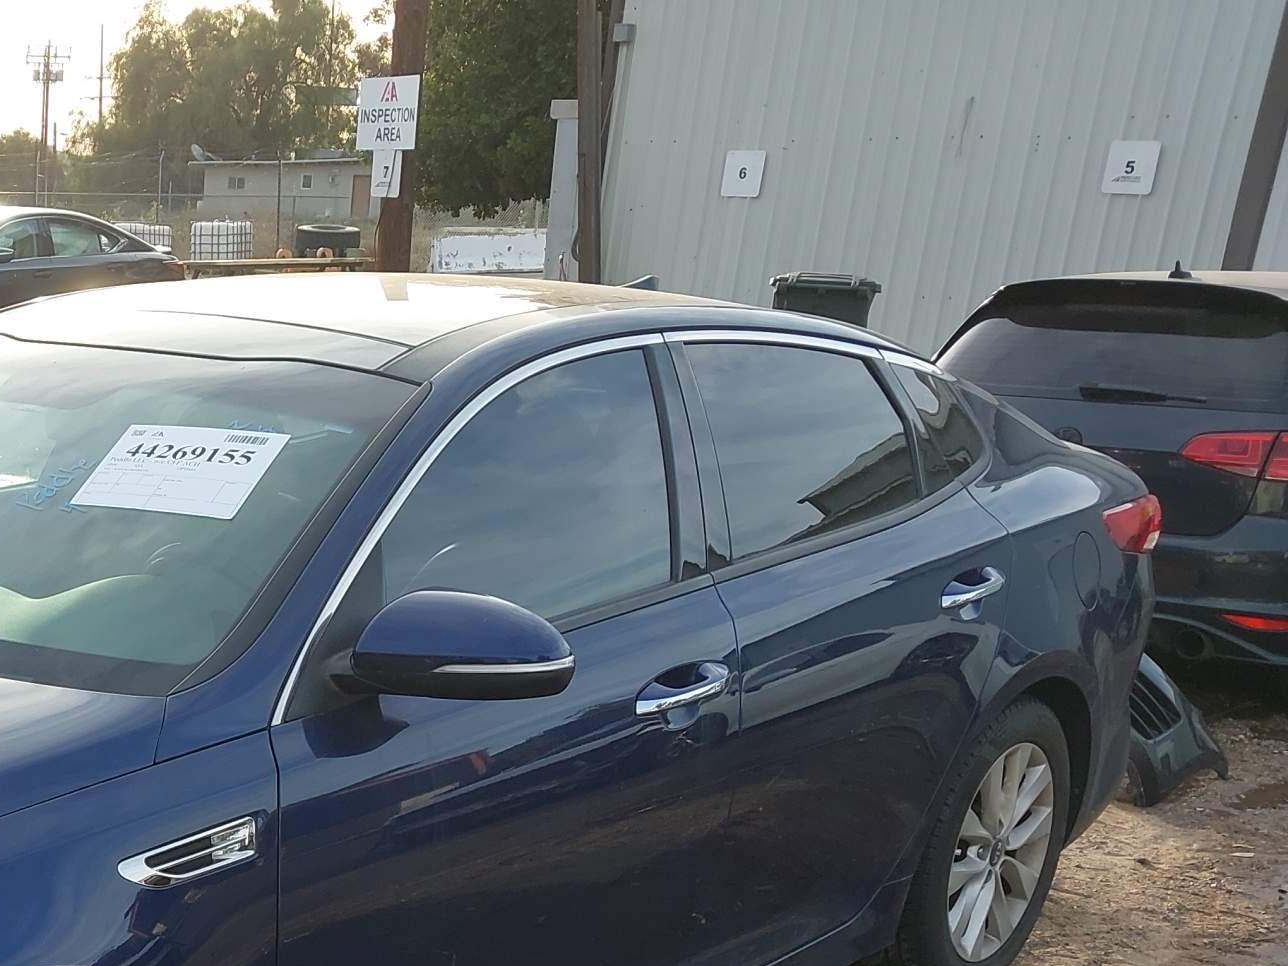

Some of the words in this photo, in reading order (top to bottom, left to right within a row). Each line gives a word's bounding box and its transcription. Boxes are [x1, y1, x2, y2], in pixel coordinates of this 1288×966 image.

[360, 107, 415, 123] INSPECTION
[374, 127, 401, 142] AREA
[383, 165, 390, 178] 7
[738, 167, 747, 180] 6
[1124, 160, 1136, 174] 5
[126, 442, 256, 466] 44269155
